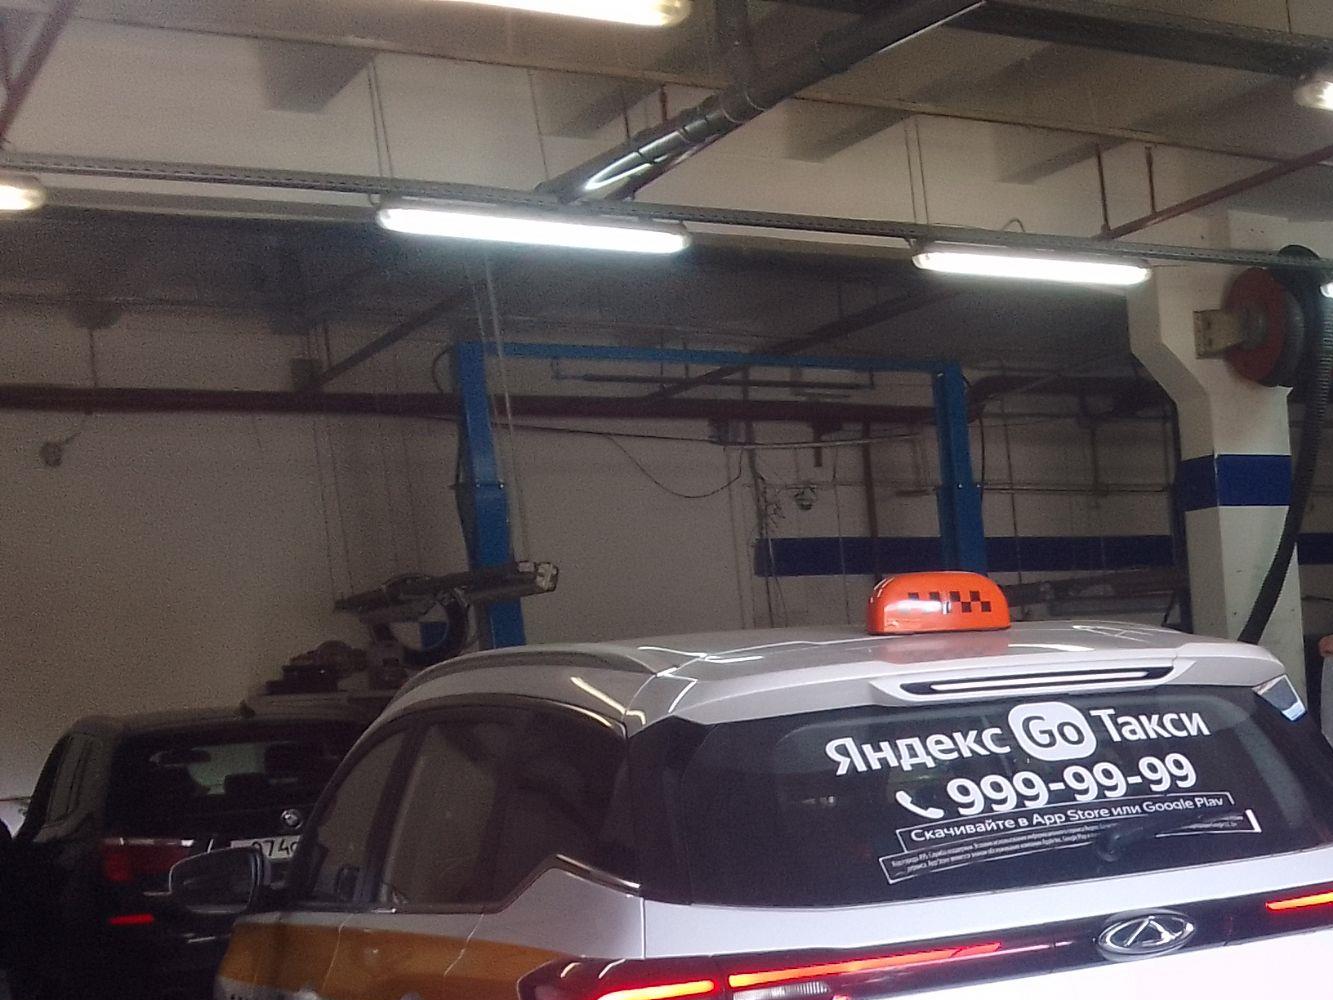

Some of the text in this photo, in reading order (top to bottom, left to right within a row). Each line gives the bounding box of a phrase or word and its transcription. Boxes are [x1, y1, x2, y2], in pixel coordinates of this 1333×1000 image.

[825, 707, 1212, 776] Яндекс Go Такси
[946, 752, 1197, 816] 999-99-99
[911, 817, 1016, 841] Скачивайте
[1018, 817, 1029, 827] в
[1032, 813, 1066, 826] App
[1067, 808, 1110, 820] Store
[1111, 805, 1142, 816] или
